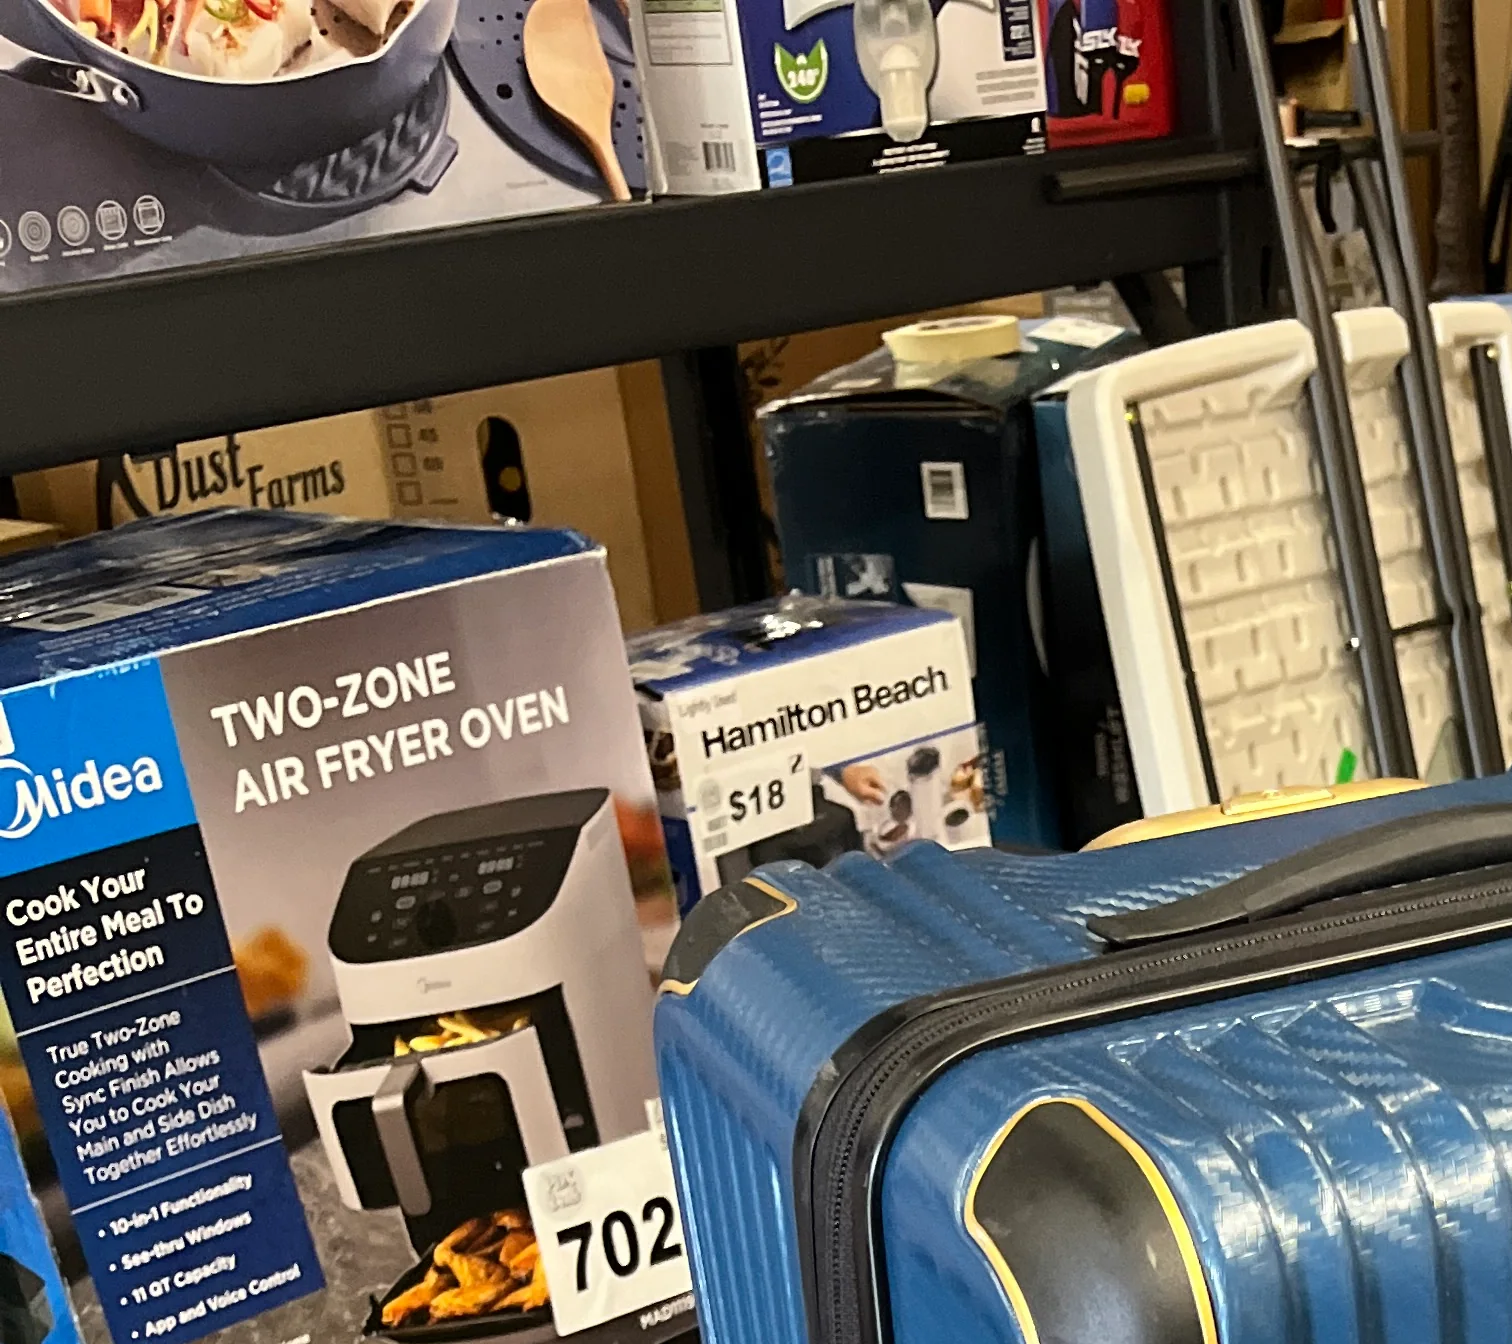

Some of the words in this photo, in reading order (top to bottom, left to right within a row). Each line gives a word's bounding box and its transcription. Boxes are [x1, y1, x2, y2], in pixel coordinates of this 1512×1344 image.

[155, 434, 244, 511] Dust
[247, 460, 345, 508] Farms
[210, 652, 455, 748] TWO-ZONE
[702, 699, 848, 758] Hamilton
[853, 666, 949, 715] Beach
[234, 759, 310, 812] AIR
[315, 719, 452, 790] FRYER
[460, 687, 570, 749] OVEN
[0, 757, 163, 839] Midea
[729, 780, 785, 822] $18
[6, 885, 80, 926] Cook
[80, 869, 146, 904] Your
[15, 926, 97, 966] Entire
[101, 899, 165, 940] Meal
[166, 892, 204, 919] To
[27, 945, 164, 1004] Perfection
[46, 1040, 89, 1063] True
[91, 1011, 181, 1049] Two-Zone
[55, 1053, 128, 1088] Cooking
[131, 1038, 170, 1063] with
[62, 1088, 107, 1114] Sync
[109, 1067, 160, 1098] Finish
[165, 1050, 220, 1078] Allows
[69, 1115, 107, 1137] You
[109, 1108, 129, 1124] to
[132, 1088, 178, 1116] Cook
[179, 1075, 220, 1098] Your
[76, 1135, 119, 1162] Main
[123, 1120, 155, 1147] and
[158, 1108, 195, 1134] Side
[198, 1094, 236, 1119] Dish
[84, 1147, 161, 1185] Together
[166, 1112, 257, 1156] Effortlessly
[109, 1206, 159, 1236] 10-in-1
[160, 1173, 252, 1218] Functionality
[121, 1237, 185, 1270] See-thru
[185, 1211, 252, 1245] Windows
[556, 1196, 682, 1294] 702
[145, 1315, 177, 1338] App
[179, 1301, 207, 1325] and
[207, 1287, 248, 1312] Voice
[249, 1262, 302, 1296] Control
[149, 1277, 171, 1298] QT
[173, 1254, 236, 1288] Capacity
